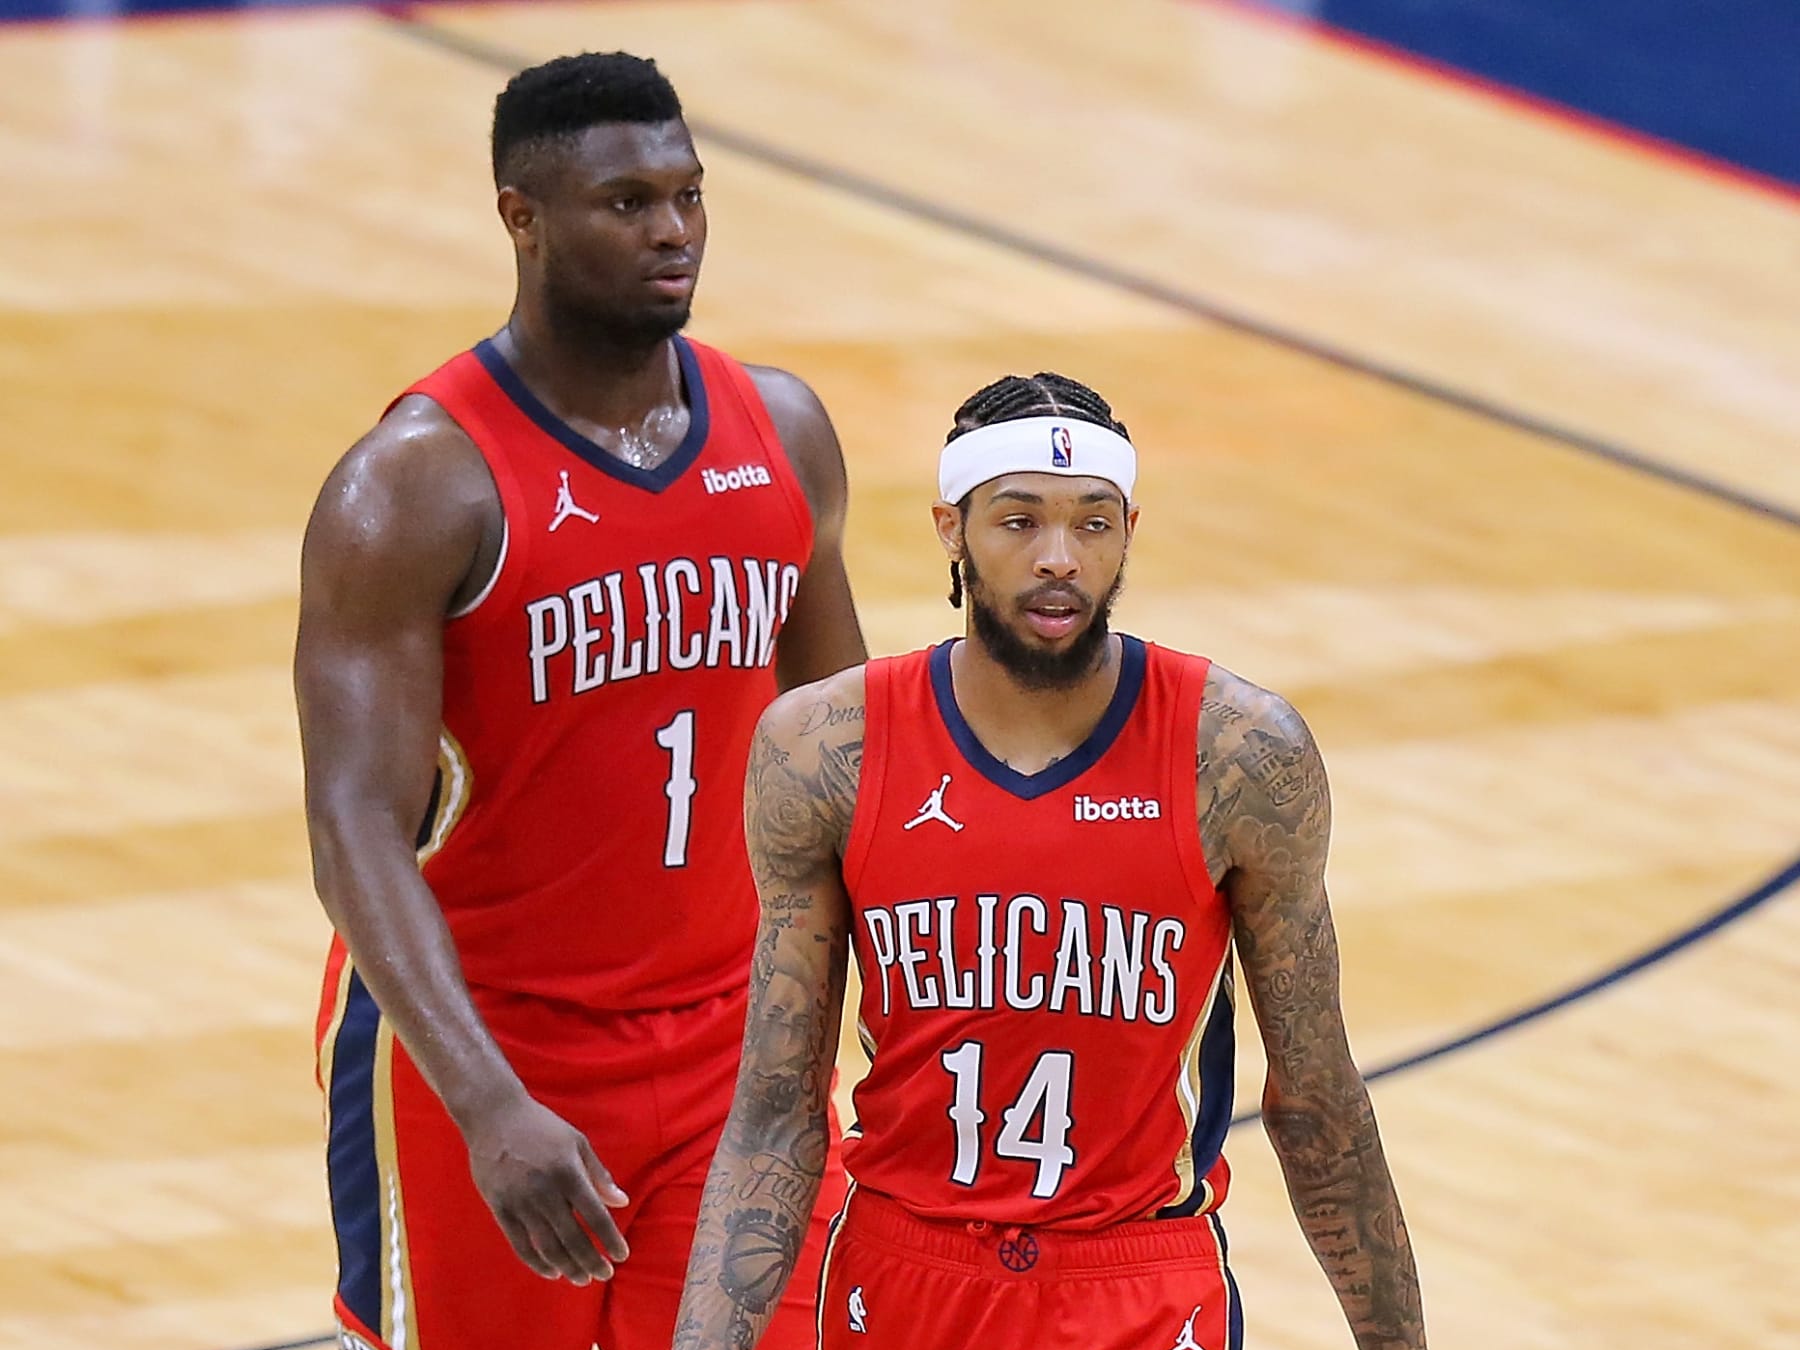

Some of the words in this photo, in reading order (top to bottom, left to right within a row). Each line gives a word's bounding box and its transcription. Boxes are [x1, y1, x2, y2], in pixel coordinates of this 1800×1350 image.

[702, 463, 771, 496] ibotta
[656, 710, 697, 868] 1
[1073, 796, 1160, 822] ibotta
[863, 894, 1185, 1025] PELICANS
[940, 1040, 1076, 1198] 14
